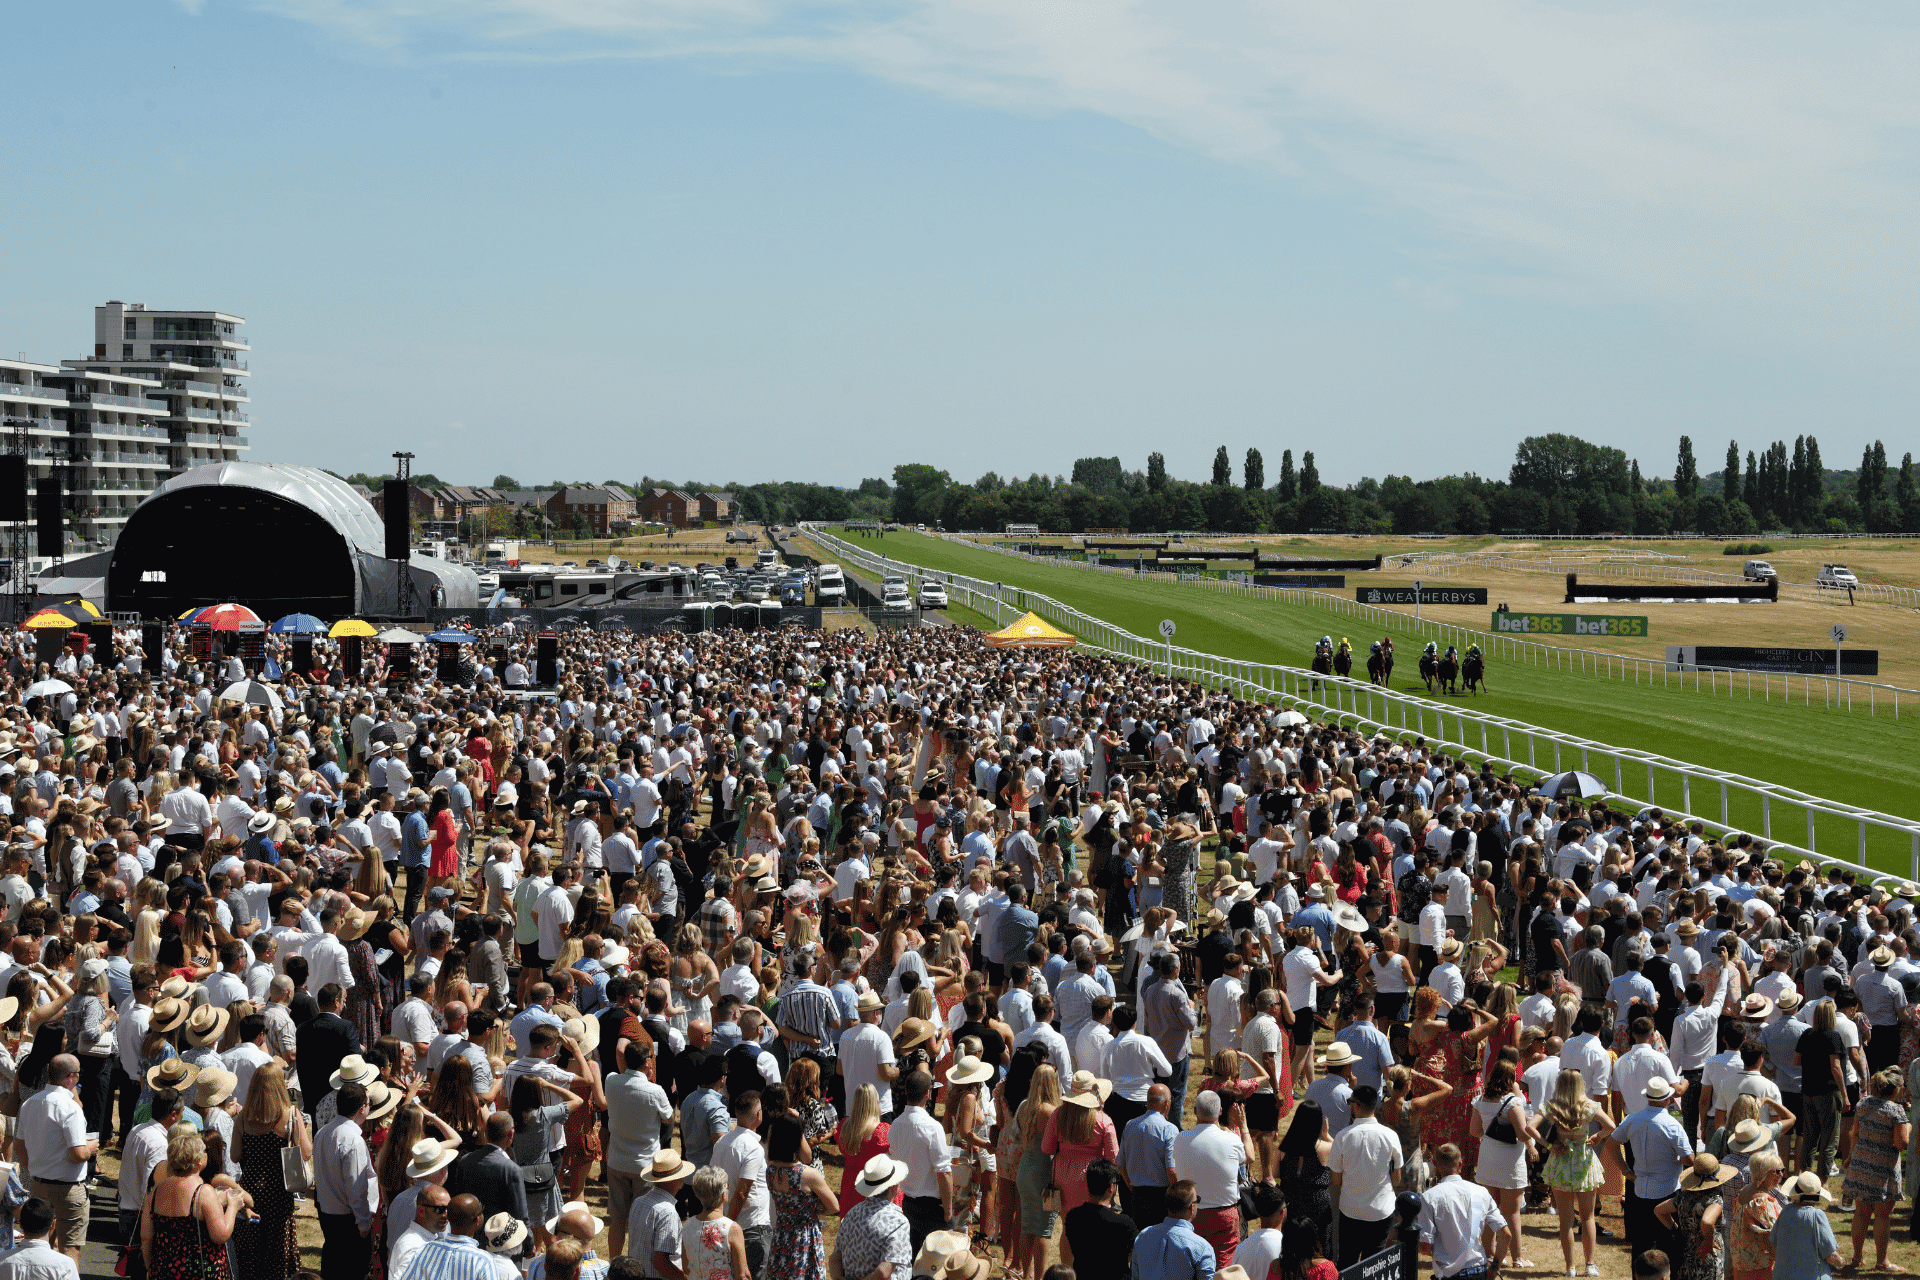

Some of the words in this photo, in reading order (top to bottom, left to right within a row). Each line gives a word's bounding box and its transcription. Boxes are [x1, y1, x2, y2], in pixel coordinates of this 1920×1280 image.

[1383, 592, 1476, 602] WEATHERBYS
[1498, 614, 1563, 632] bet365
[1575, 616, 1642, 635] bet365
[1797, 651, 1825, 662] GIN
[1363, 1260, 1387, 1278] Hampshire
[1388, 1249, 1401, 1266] Stand
